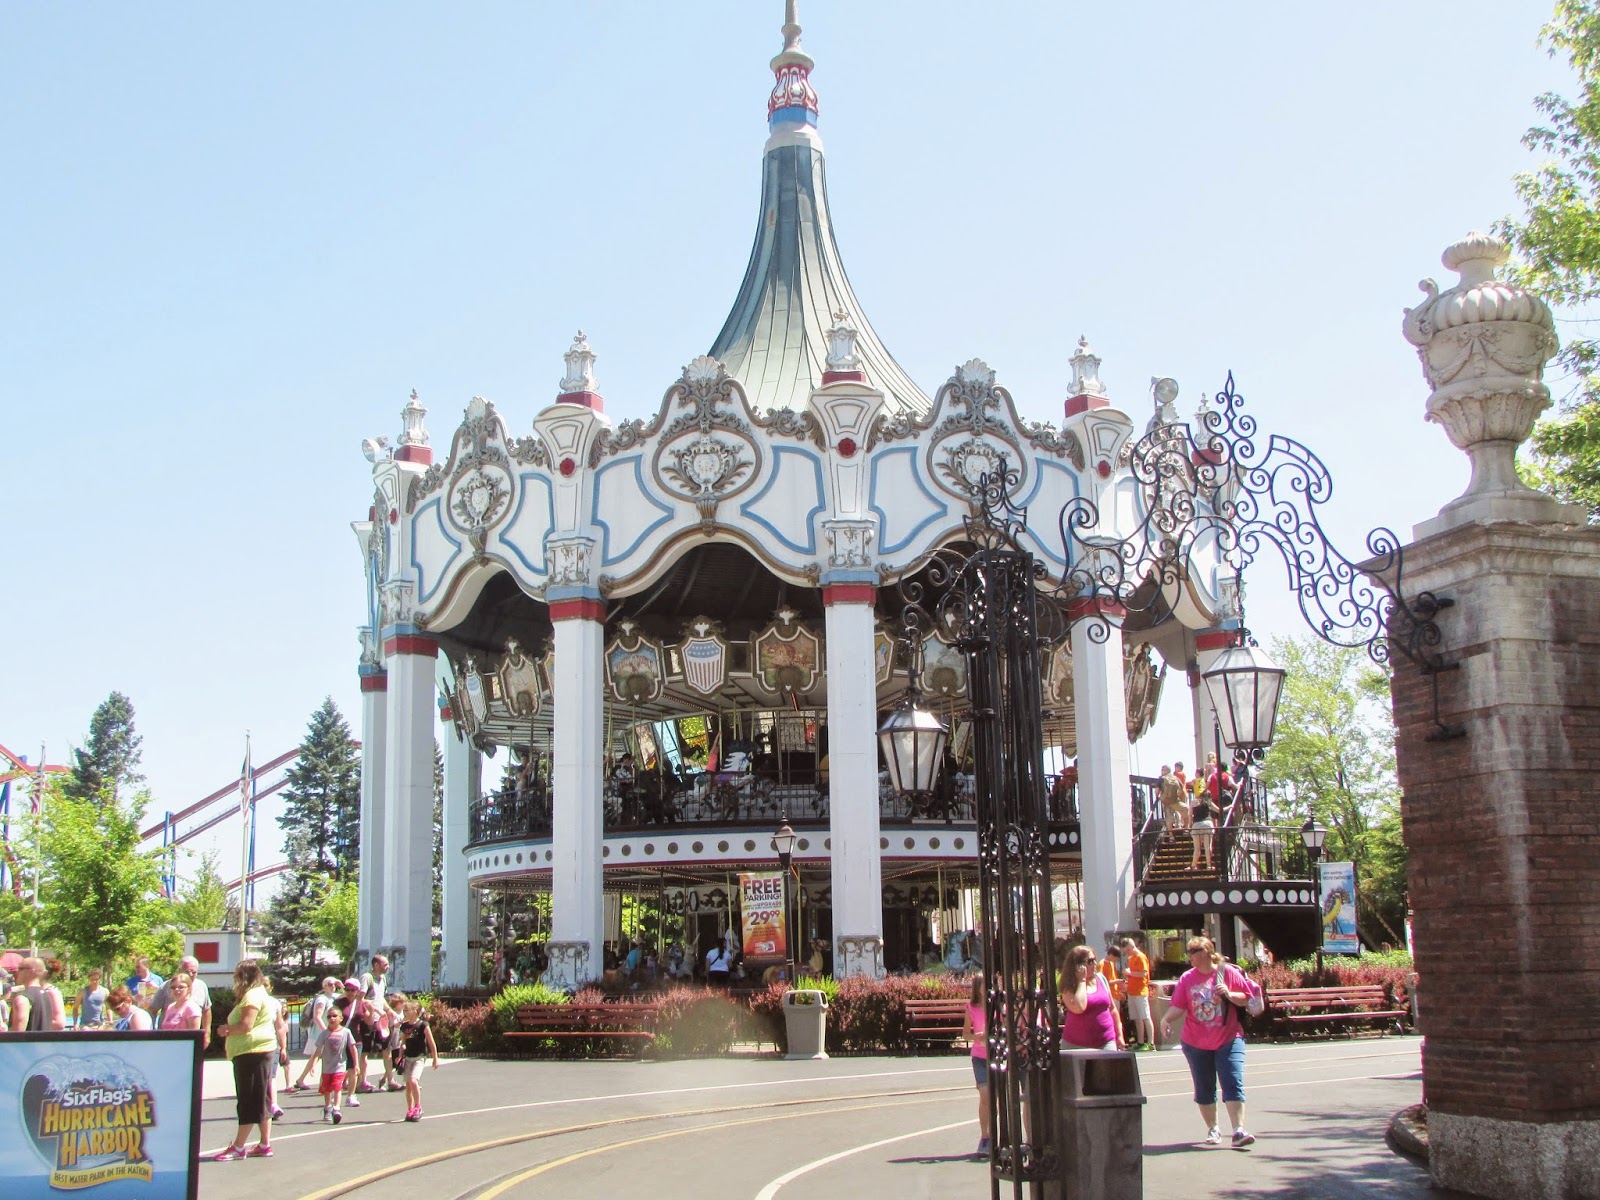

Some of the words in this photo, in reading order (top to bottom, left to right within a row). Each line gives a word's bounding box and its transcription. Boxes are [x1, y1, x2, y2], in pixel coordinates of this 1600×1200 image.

[743, 878, 782, 894] FREE
[744, 892, 782, 902] PARKING!
[44, 1093, 152, 1133] HURRICANE
[61, 1127, 143, 1166] HARBOR
[54, 1172, 68, 1183] BEST
[69, 1173, 88, 1183] WATER
[89, 1170, 106, 1181] PARK
[107, 1168, 115, 1177] IN
[116, 1166, 126, 1175] THE
[127, 1165, 150, 1177] NATION
